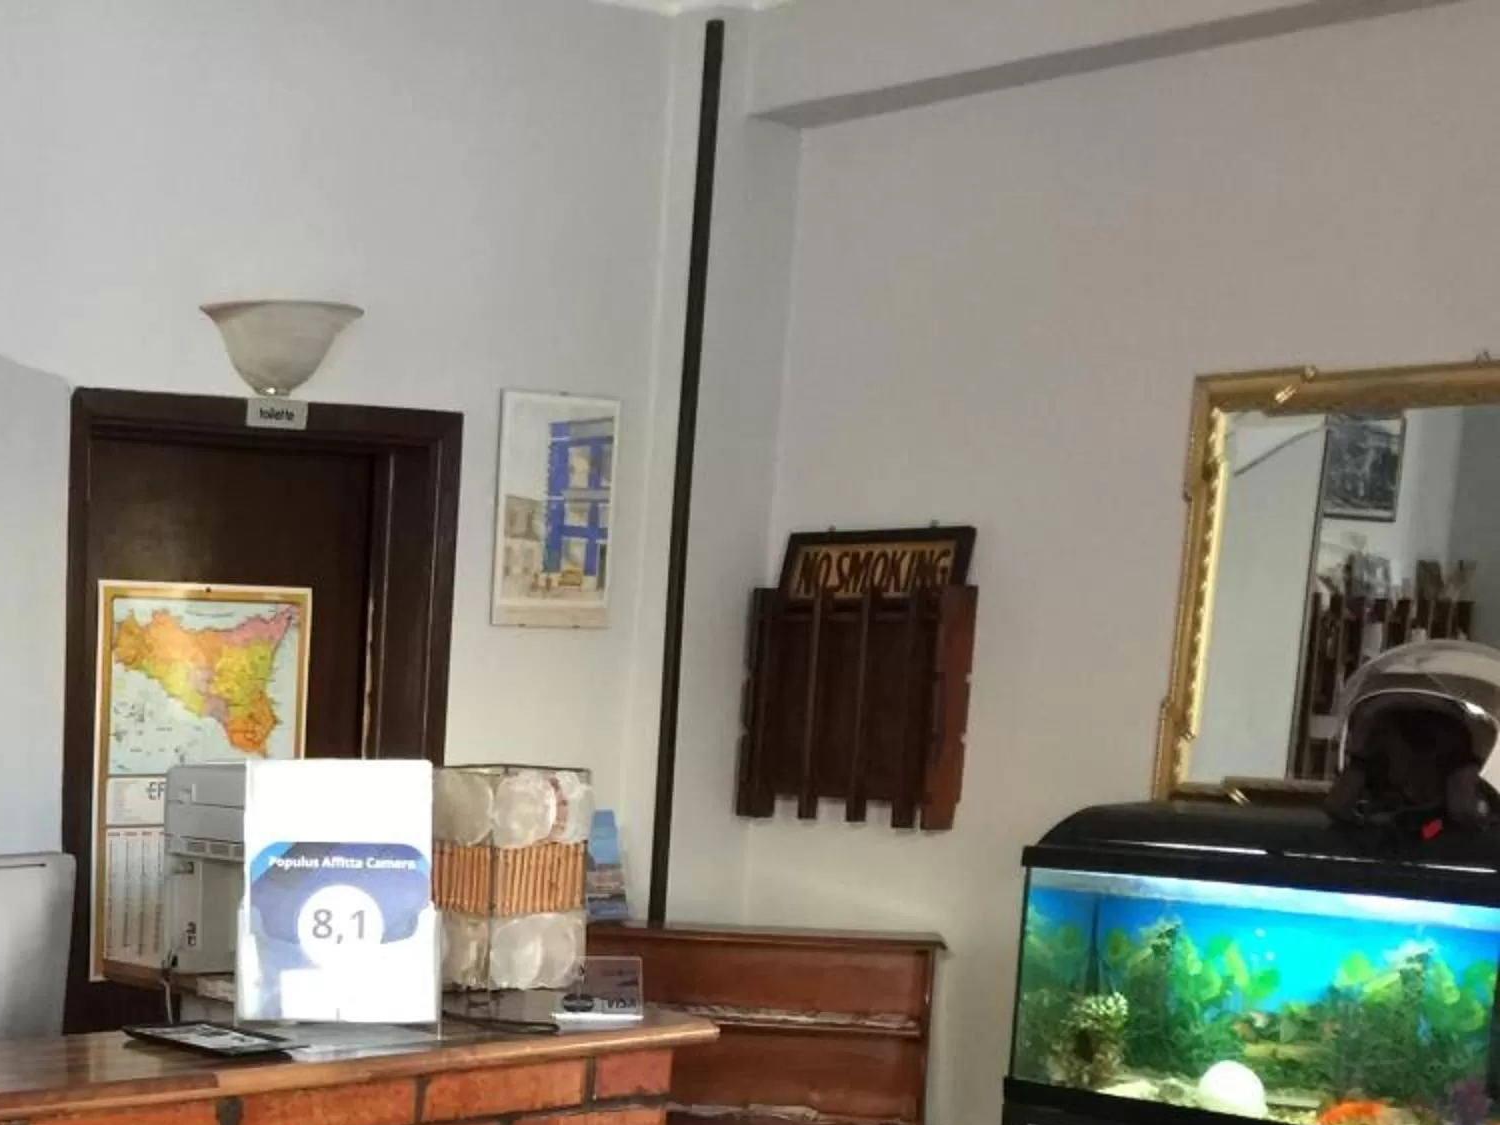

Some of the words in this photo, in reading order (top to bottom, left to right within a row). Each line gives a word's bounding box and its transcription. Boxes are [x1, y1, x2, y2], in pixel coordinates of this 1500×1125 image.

[269, 856, 319, 871] Populus
[321, 856, 363, 869] Affitta
[311, 908, 366, 944] 8,1
